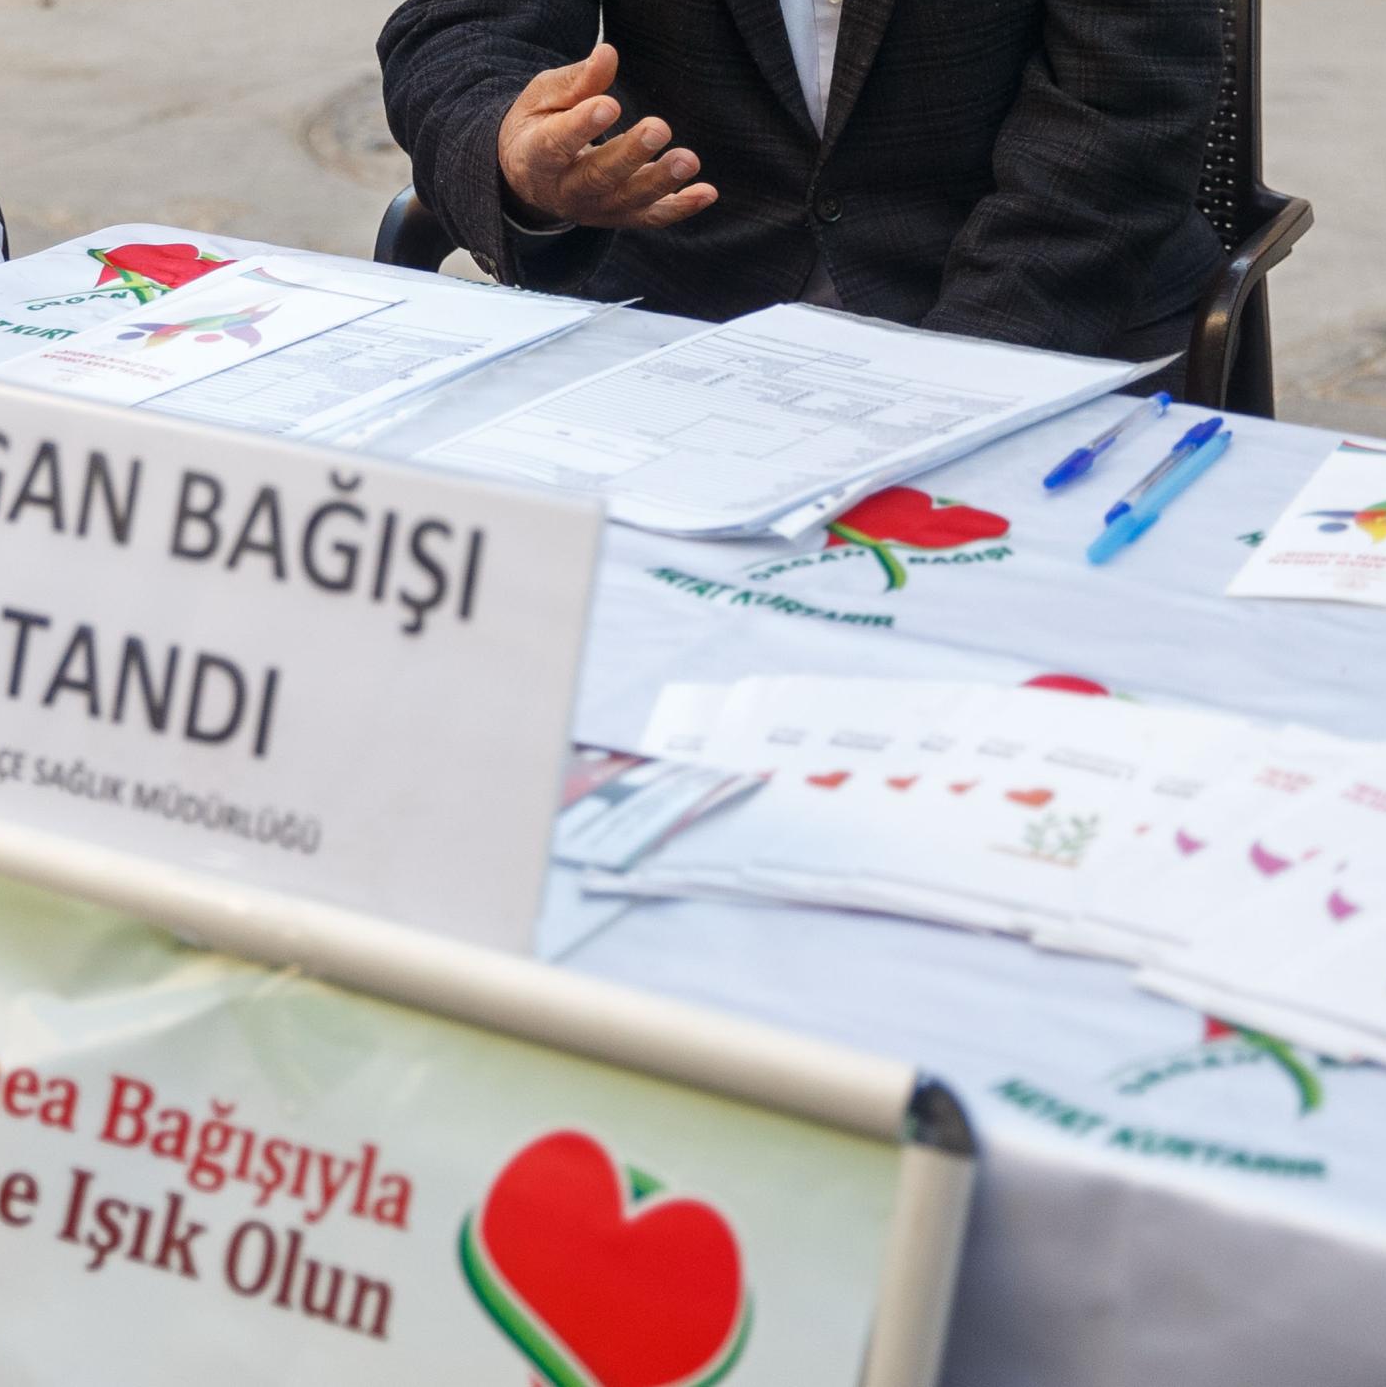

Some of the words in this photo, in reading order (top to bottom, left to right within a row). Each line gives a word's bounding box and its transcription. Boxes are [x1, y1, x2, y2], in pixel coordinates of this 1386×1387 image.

[6, 325, 80, 341] KURT
[26, 291, 129, 311] ORGAN
[169, 470, 487, 636] BAĞIŞI
[748, 550, 868, 582] ORGAN
[33, 756, 126, 805] SAĞLIK
[130, 781, 323, 855] MÜDÜRLÜĞÜ
[98, 1074, 418, 1231] Bağışıyla
[57, 1166, 203, 1282] Işık
[222, 1220, 396, 1340] Olun
